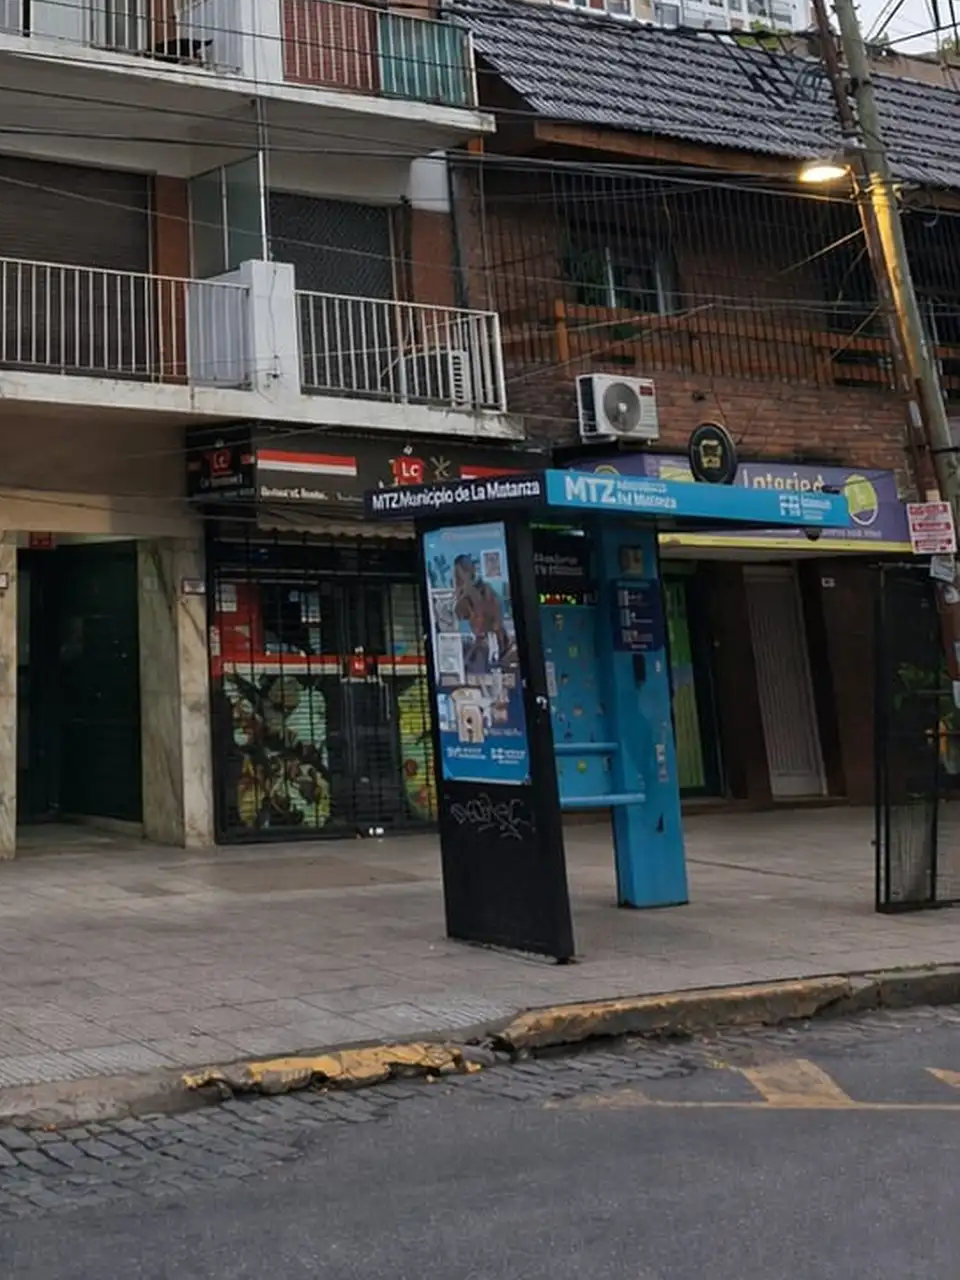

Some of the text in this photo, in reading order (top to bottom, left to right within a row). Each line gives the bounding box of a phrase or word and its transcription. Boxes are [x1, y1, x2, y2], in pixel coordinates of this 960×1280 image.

[455, 488, 470, 503] de
[471, 484, 485, 500] La
[565, 475, 616, 503] MTZ
